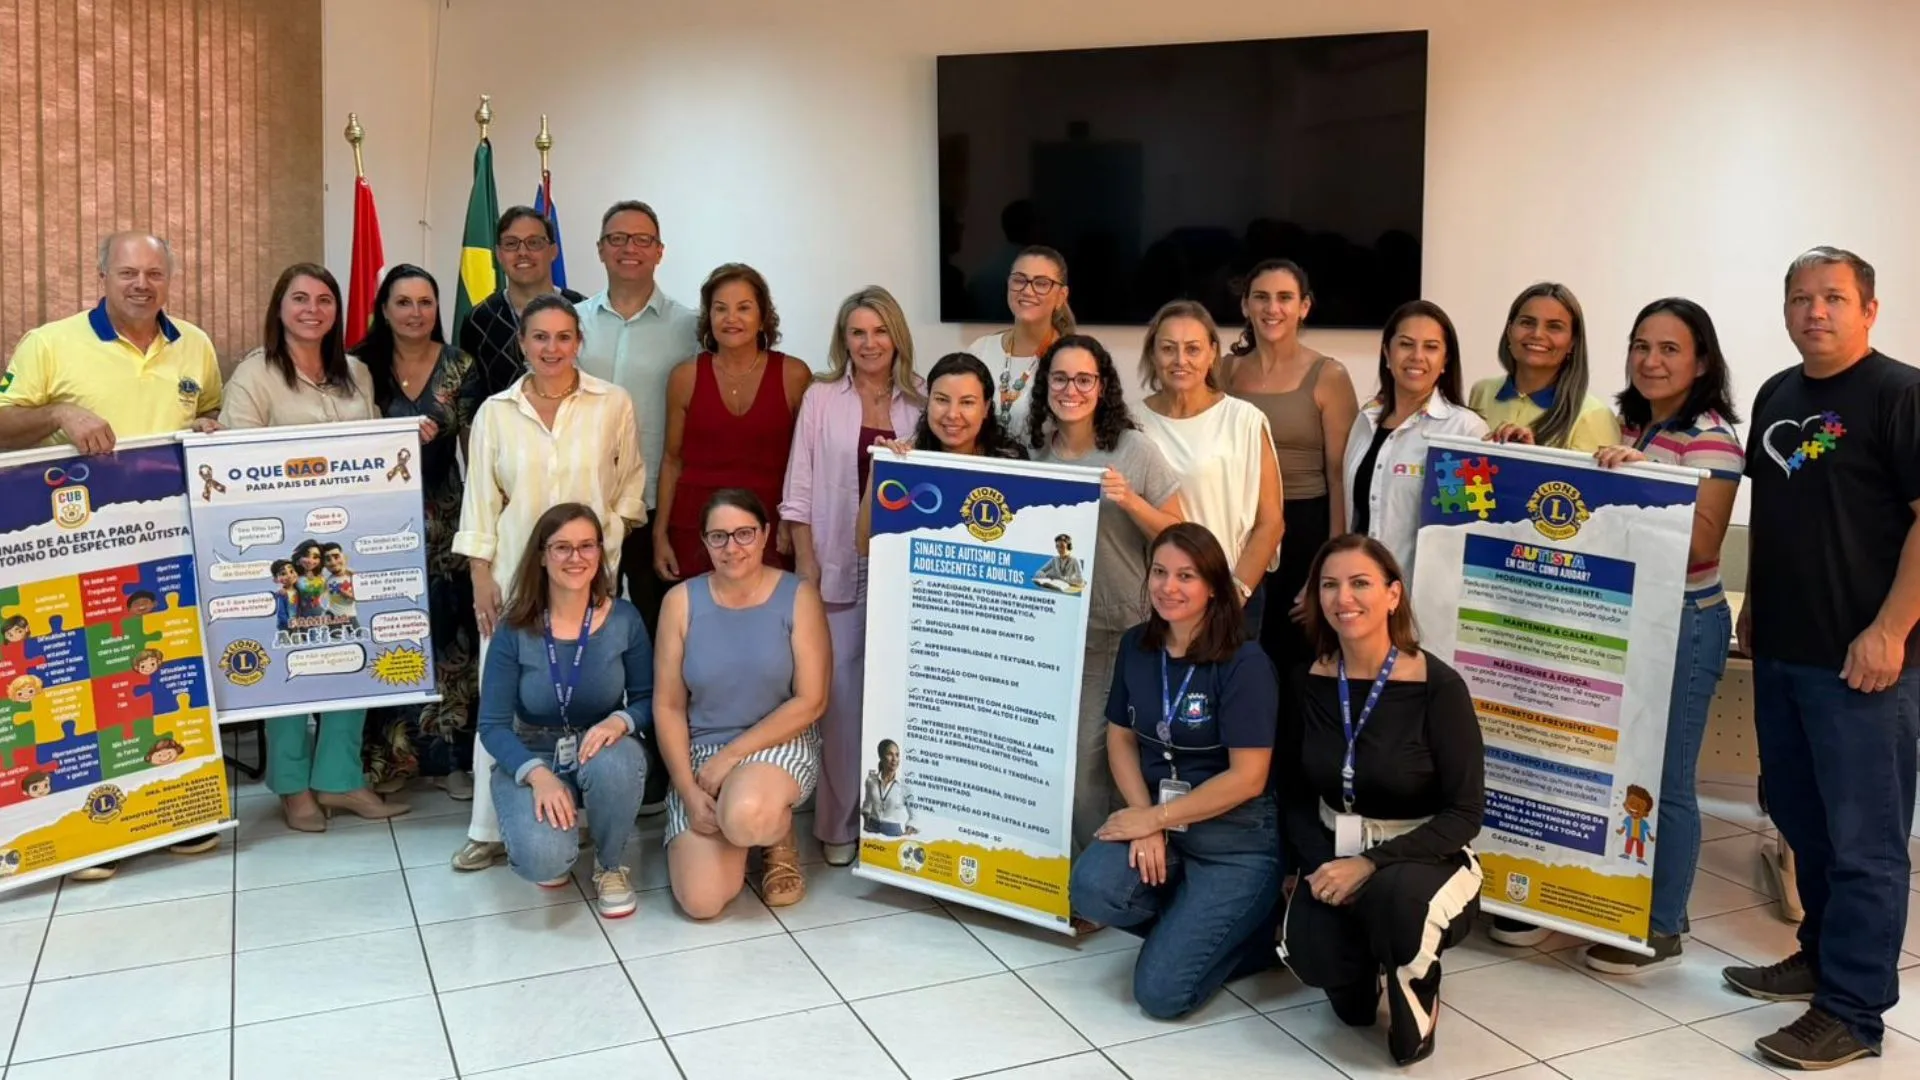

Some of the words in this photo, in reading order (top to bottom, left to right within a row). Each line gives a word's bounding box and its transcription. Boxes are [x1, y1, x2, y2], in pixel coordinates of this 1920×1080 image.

[228, 468, 241, 480] O
[246, 465, 283, 482] QUE
[288, 460, 327, 477] NÃO
[330, 458, 385, 472] FALAR
[246, 482, 274, 491] PARA
[277, 480, 300, 489] PAIS
[304, 479, 317, 487] DE
[319, 475, 370, 486] AUTISTAS
[1539, 483, 1577, 499] LIONS
[58, 490, 82, 503] CUB
[972, 487, 1002, 502] LIONS
[980, 504, 993, 523] L
[1552, 499, 1565, 520] L
[0, 542, 33, 556] INAIS
[37, 538, 53, 549] DE
[56, 529, 105, 545] ALERTA
[108, 522, 142, 537] PARA
[144, 521, 155, 530] O
[0, 552, 46, 567] TORNO
[50, 546, 69, 558] DO
[73, 535, 136, 554] ESPECTRO
[139, 526, 190, 544] AUTISTA
[915, 541, 943, 557] SINAIS
[945, 544, 956, 558] DE
[957, 545, 996, 564] AUTISMO
[998, 551, 1010, 566] EM
[1512, 544, 1585, 569] AUTISTA
[913, 556, 977, 577] ADOLESCENTES
[980, 566, 984, 578] E
[986, 566, 1023, 584] ADULTOS
[1505, 557, 1516, 568] EM
[1538, 563, 1559, 576] COMO
[1560, 566, 1591, 581] AJUDAR?
[913, 587, 942, 596] SOZINHO
[976, 596, 998, 604] TOCAR
[927, 580, 971, 592] CAPACIDADE
[1020, 594, 1056, 605] APRENDER
[1495, 573, 1542, 588] MODIFIQUE
[1554, 584, 1601, 598] AMBIENTE:
[912, 602, 958, 614] ENGENHARIAS
[925, 619, 969, 631] DIFICULDADE
[998, 630, 1022, 640] DIANTE
[1502, 618, 1551, 633] MANTENHA
[229, 640, 260, 652] LIONS
[910, 647, 939, 657] CHEIROS
[924, 642, 991, 658] HIPERSENSIBILIDADE
[1037, 661, 1054, 670] SONS
[240, 653, 252, 670] L
[924, 664, 960, 676] IRRITAÇÃO
[979, 673, 1008, 685] QUEBRAS
[1493, 659, 1510, 669] NÃO
[1514, 664, 1547, 678] SEGURE
[1557, 674, 1590, 688] FORÇA:
[922, 688, 945, 697] EVITAR
[947, 692, 984, 704] AMBIENTES
[985, 699, 1000, 708] COM
[908, 694, 934, 703] MUITAS
[977, 706, 990, 714] SOM
[992, 709, 1012, 719] ALTOS
[1019, 716, 1038, 725] LUZES
[1480, 702, 1499, 712] SEJA
[1500, 706, 1533, 720] DIRETO
[906, 732, 937, 743] ESPACIAL
[944, 738, 989, 754] AERONÁUTICA
[991, 748, 1010, 759] ENTRE
[907, 724, 927, 733] COMO
[1007, 744, 1032, 756] CIÊNCIA
[921, 718, 955, 730] INTERESSE
[957, 725, 987, 737] RESTRITO
[994, 733, 1024, 746] RACIONAL
[1032, 741, 1054, 754] ÁREAS
[920, 749, 943, 759] POUCO
[944, 754, 977, 766] INTERESSE
[980, 762, 1002, 773] SOCIAL
[1008, 768, 1043, 784] TENDÊNCIA
[1510, 753, 1540, 766] TEMPO
[1543, 761, 1554, 770] DA
[904, 777, 926, 787] OLHAR
[918, 772, 960, 787] SINCERIDADE
[1003, 792, 1026, 804] DESVIO
[100, 796, 111, 809] L
[1499, 791, 1523, 804] VALIDE
[1525, 797, 1535, 807] OS
[1538, 801, 1590, 821] SENTIMENTOS
[1592, 814, 1603, 824] DA
[991, 813, 999, 821] DA
[1001, 815, 1021, 827] LETRA
[1027, 823, 1049, 834] APEGO
[1498, 819, 1542, 838] DIFERENÇA!
[1504, 812, 1517, 821] SEU
[1520, 816, 1542, 828] APOIO
[1545, 822, 1558, 832] FAZ
[1560, 826, 1581, 837] TODA
[1531, 810, 1570, 826] ENTENDER
[1579, 822, 1595, 832] QUE
[958, 826, 988, 839] CAÇADOR
[1491, 832, 1528, 848] CAÇADOR
[1535, 843, 1545, 851] SC
[961, 856, 976, 868] CUB
[1510, 873, 1528, 886] CUB
